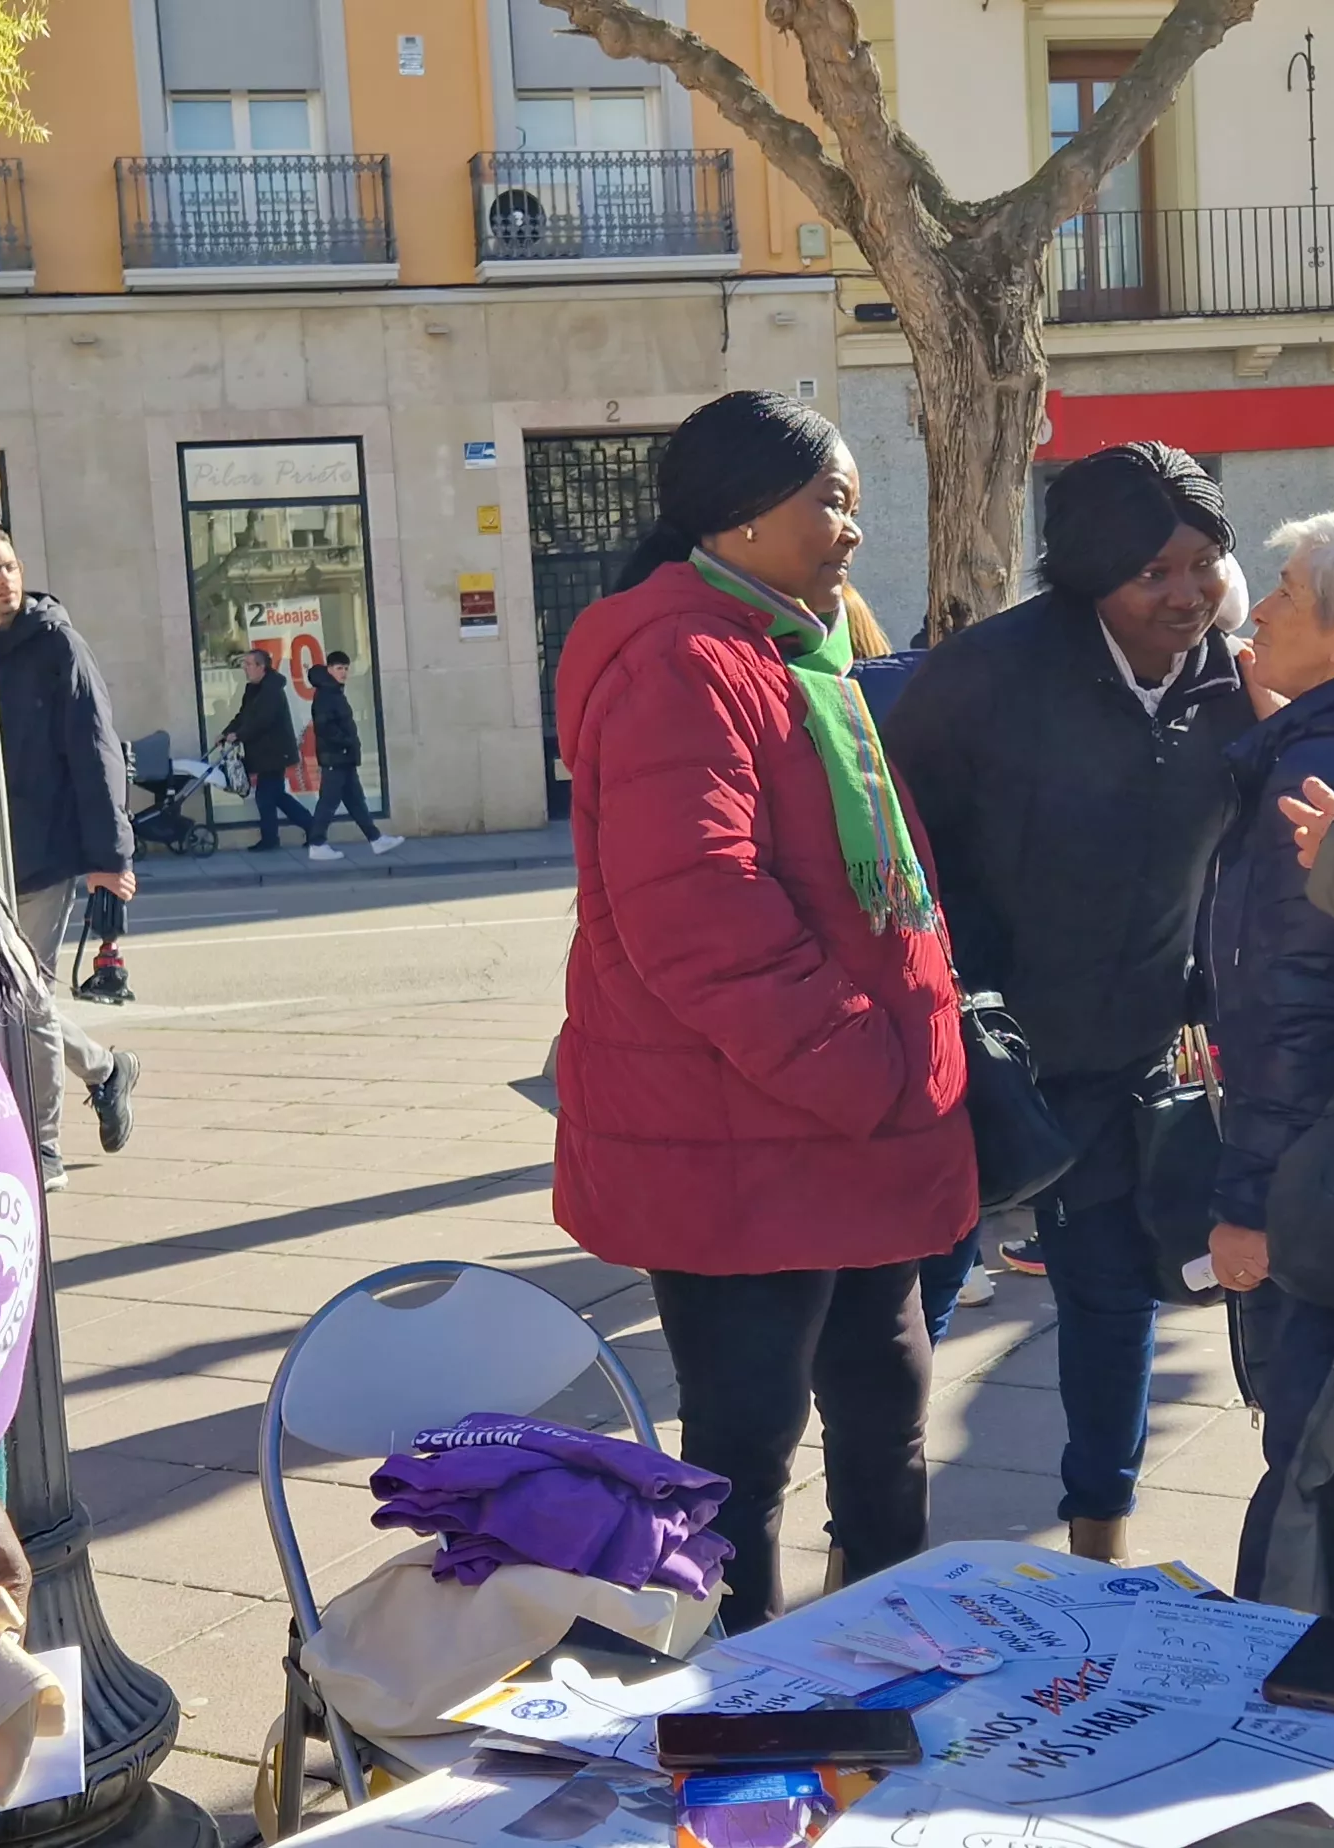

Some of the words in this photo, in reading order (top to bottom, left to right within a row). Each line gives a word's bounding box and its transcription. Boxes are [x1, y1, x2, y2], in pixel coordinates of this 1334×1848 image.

[606, 401, 620, 422] 2
[267, 607, 319, 626] Rebajas
[1007, 1739, 1097, 1778] MÁS
[1062, 1699, 1166, 1741] HABLA
